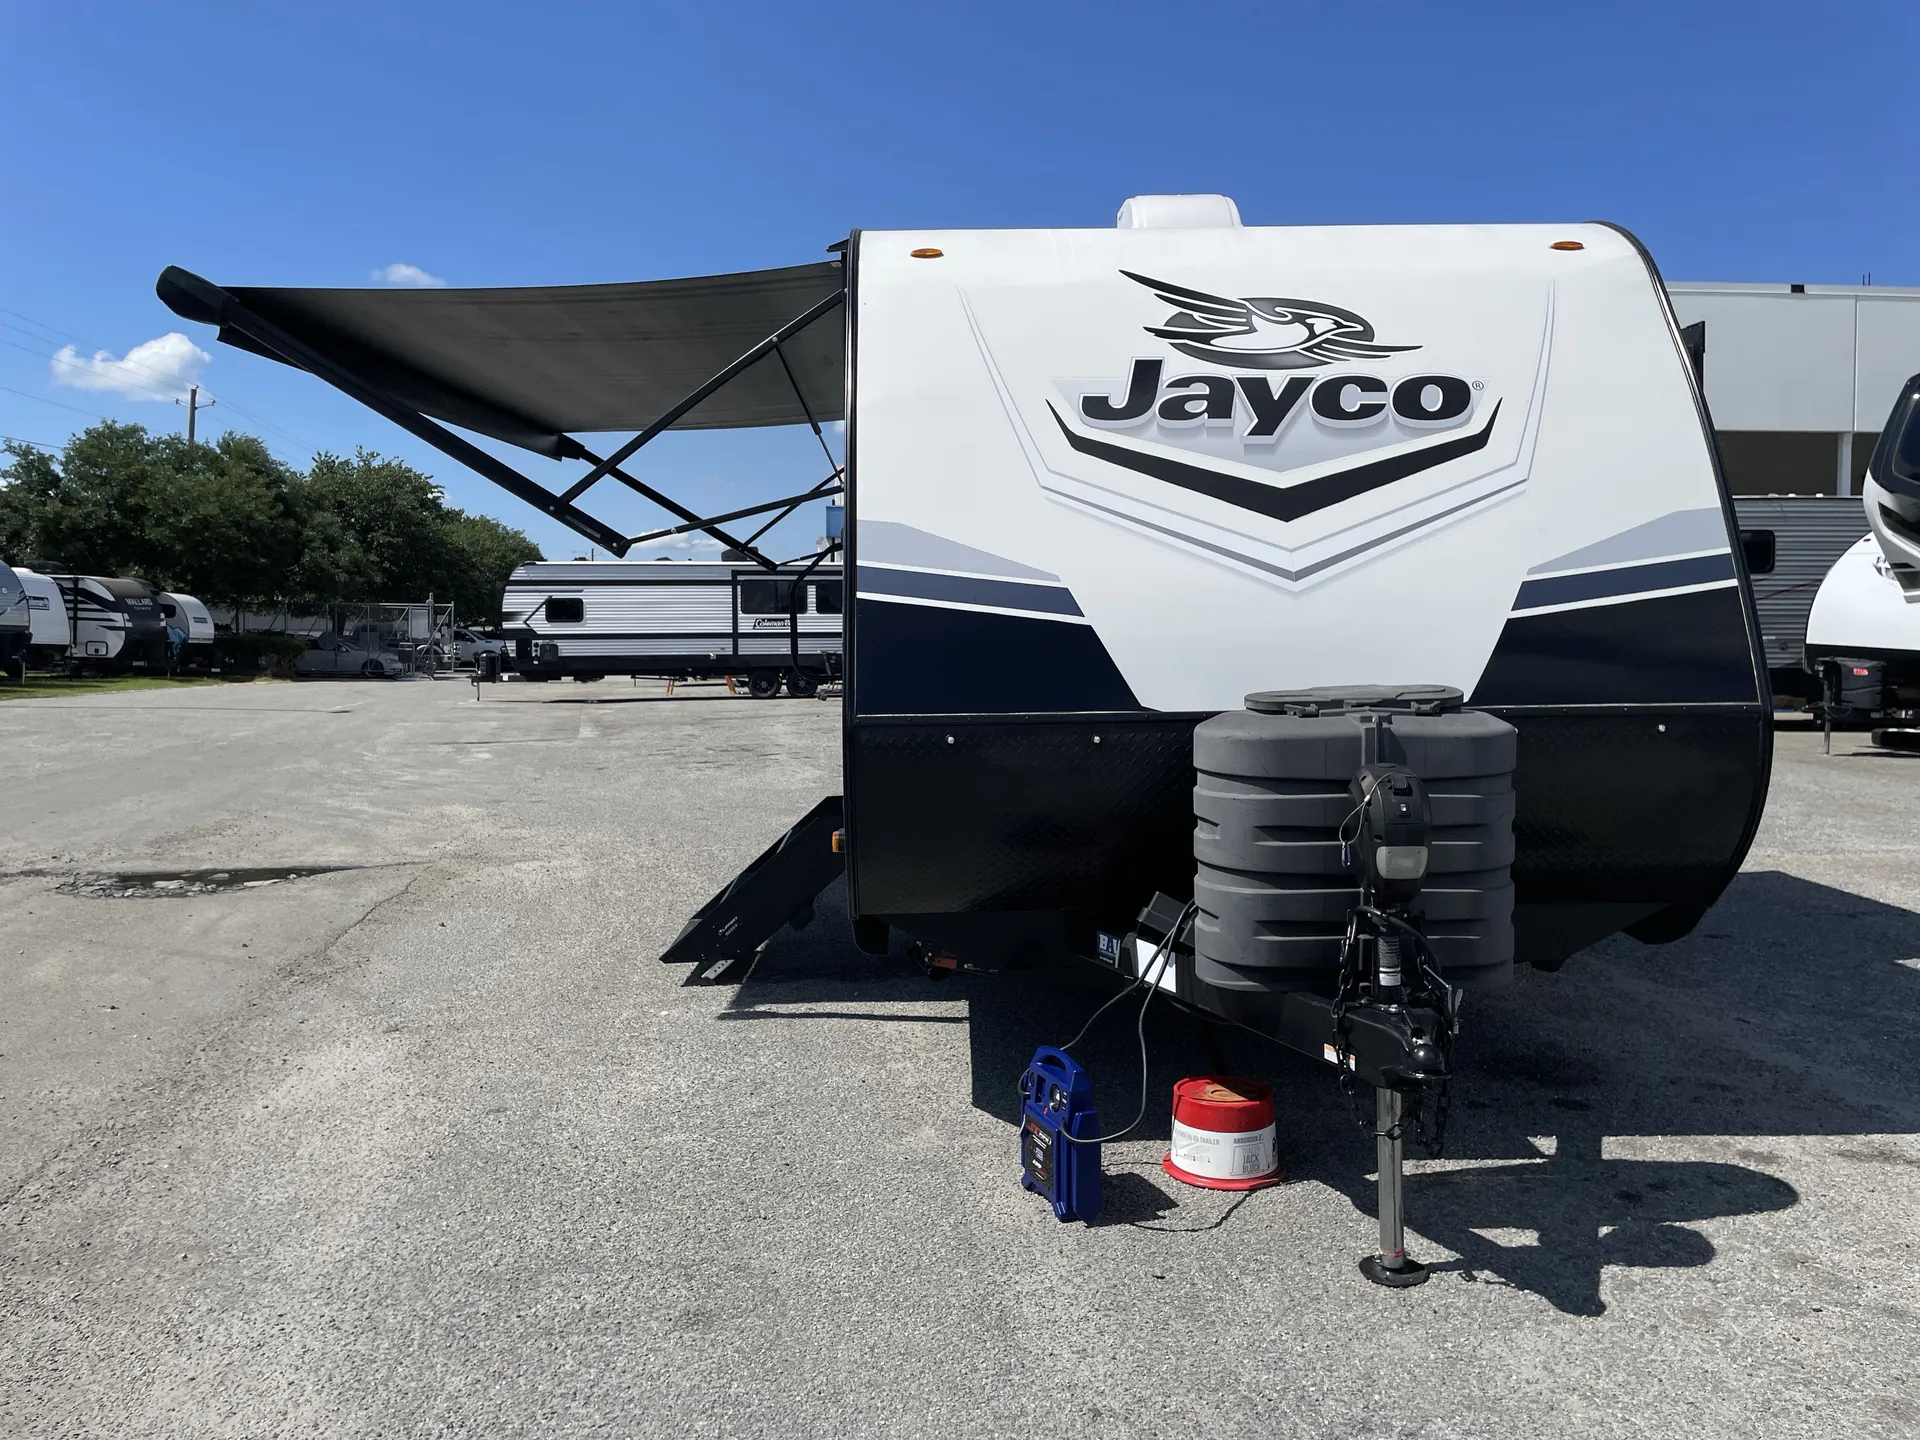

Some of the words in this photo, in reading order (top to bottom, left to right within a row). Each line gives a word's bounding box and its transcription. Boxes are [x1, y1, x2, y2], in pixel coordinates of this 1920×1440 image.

[1079, 357, 1473, 442] Jayco
[125, 597, 153, 606] MALLARD
[755, 619, 784, 627] Coleman
[1243, 1153, 1260, 1165] JACK
[1242, 1163, 1261, 1173] BLOCK
